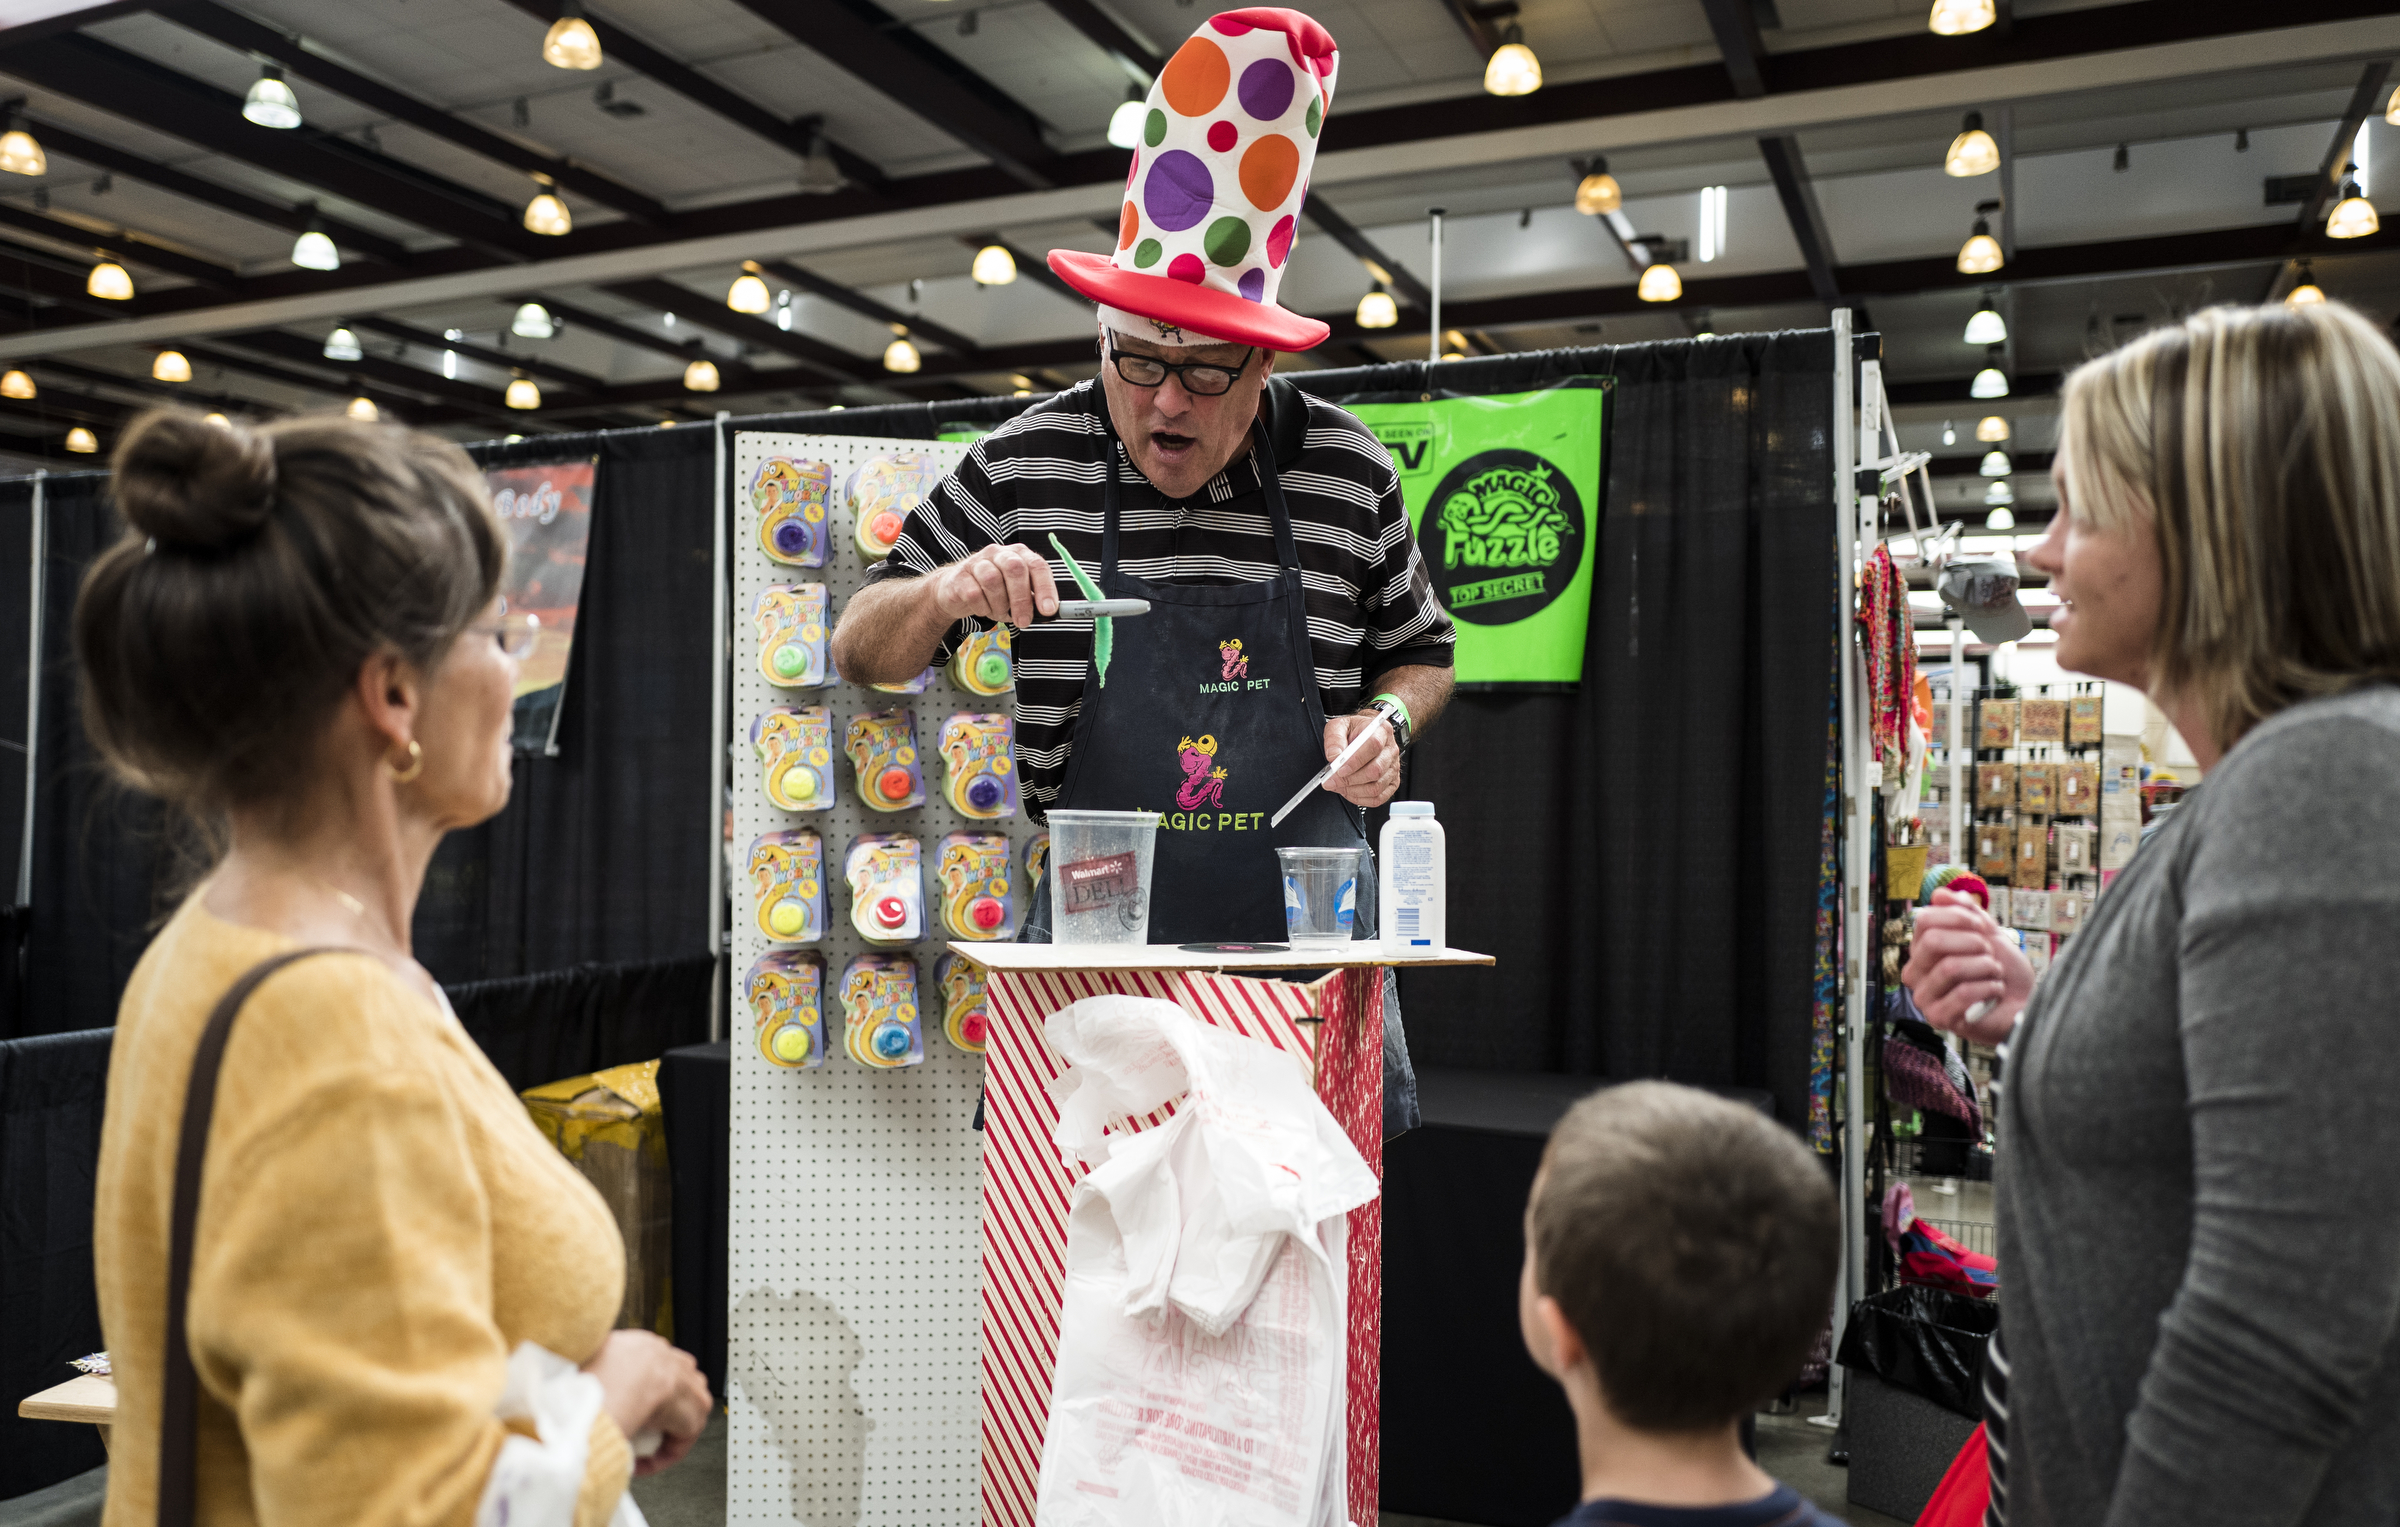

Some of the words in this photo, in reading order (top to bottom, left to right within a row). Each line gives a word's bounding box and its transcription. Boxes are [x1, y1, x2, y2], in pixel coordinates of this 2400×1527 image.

[1385, 429, 1413, 438] SEEN
[1382, 440, 1428, 470] V
[780, 479, 829, 494] TWISTY
[877, 472, 922, 488] TWISTY
[1472, 472, 1553, 504] MAGIC
[782, 490, 824, 503] WORM
[880, 484, 919, 498] WORM
[494, 481, 561, 524] Body
[1445, 522, 1561, 568] Fuzzle
[1450, 586, 1480, 604] TOP
[1482, 576, 1545, 598] SECRET
[777, 603, 823, 618] TWISTY
[780, 613, 820, 629] WORM
[1199, 680, 1239, 694] MAGIC
[1246, 678, 1270, 691] PET
[781, 727, 829, 742] TWISTY
[867, 727, 911, 746] TWISTY
[965, 735, 1011, 750] TWISTY
[786, 736, 827, 752] WORM
[872, 735, 912, 755] WORM
[969, 745, 1009, 760] WORM
[1218, 812, 1265, 831] PET
[771, 859, 820, 874] TWISTY
[872, 859, 919, 872] TWISTY
[962, 857, 1009, 873] TWISTY
[1071, 865, 1109, 880] Walmart
[775, 868, 816, 883] WORM
[874, 867, 916, 883] WORM
[965, 867, 1006, 881] WORM
[1073, 878, 1124, 904] DELI
[771, 986, 819, 1001] TWISTY
[872, 992, 912, 1010] WORM
[776, 995, 816, 1011] WORM
